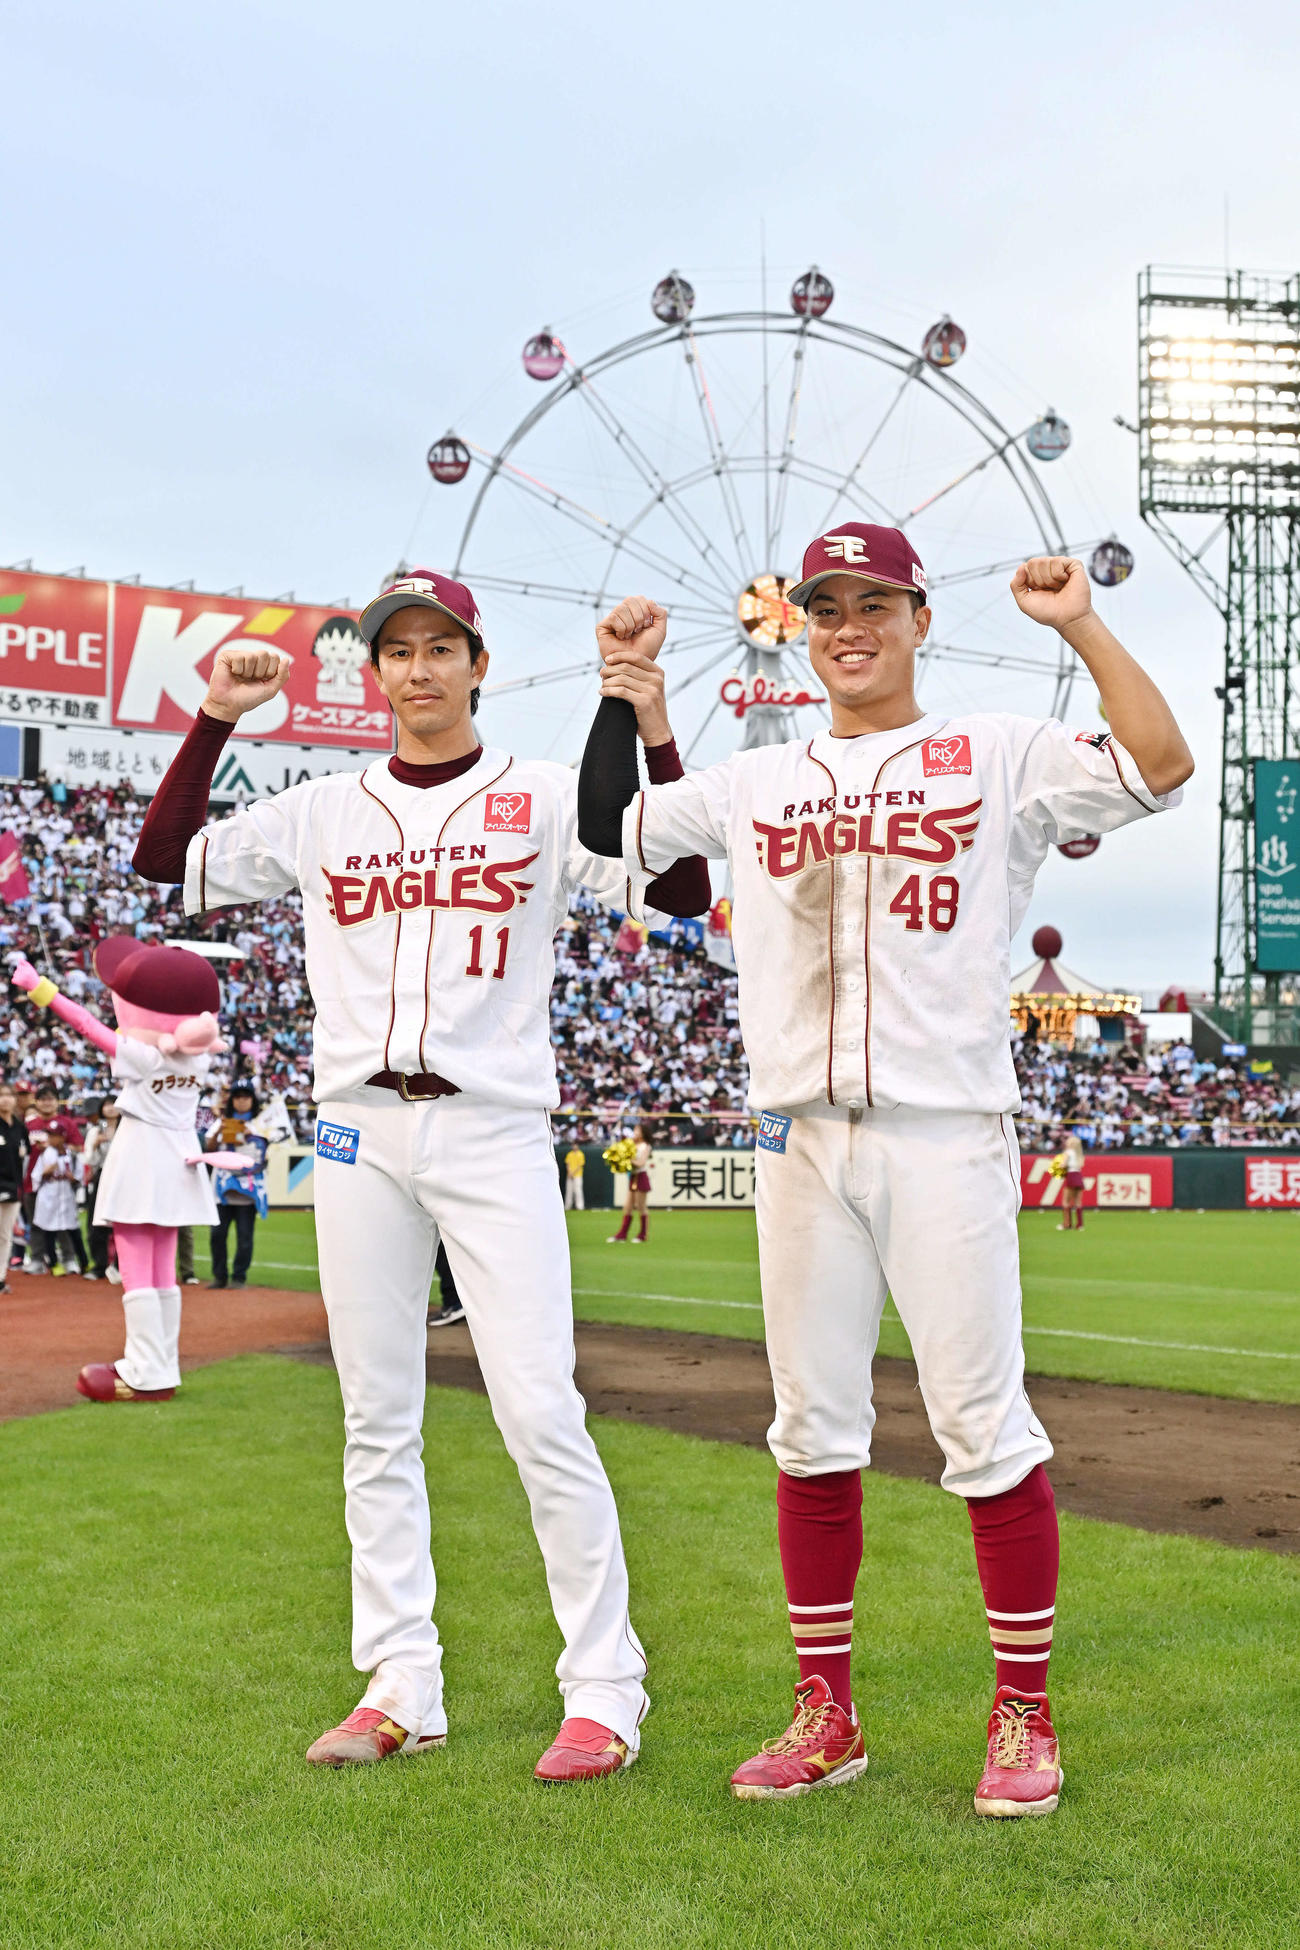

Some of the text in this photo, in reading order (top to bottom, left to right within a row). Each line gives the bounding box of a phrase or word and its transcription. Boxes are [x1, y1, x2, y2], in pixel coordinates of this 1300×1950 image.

[0, 690, 99, 719] るや不動産
[721, 678, 826, 718] Glico
[67, 747, 172, 775] 地域ととも
[266, 768, 331, 795] JA
[783, 790, 925, 821] RAKUTEN
[752, 798, 982, 880] EAGLES
[345, 845, 487, 870] RAKUTEN
[321, 851, 540, 929] EAGLES
[889, 874, 960, 933] 48
[464, 924, 511, 980] 11
[319, 1124, 356, 1148] Fuji
[317, 1144, 351, 1160] タイヤはフジ
[671, 1157, 756, 1200] 東北
[1102, 1178, 1147, 1201] ネット
